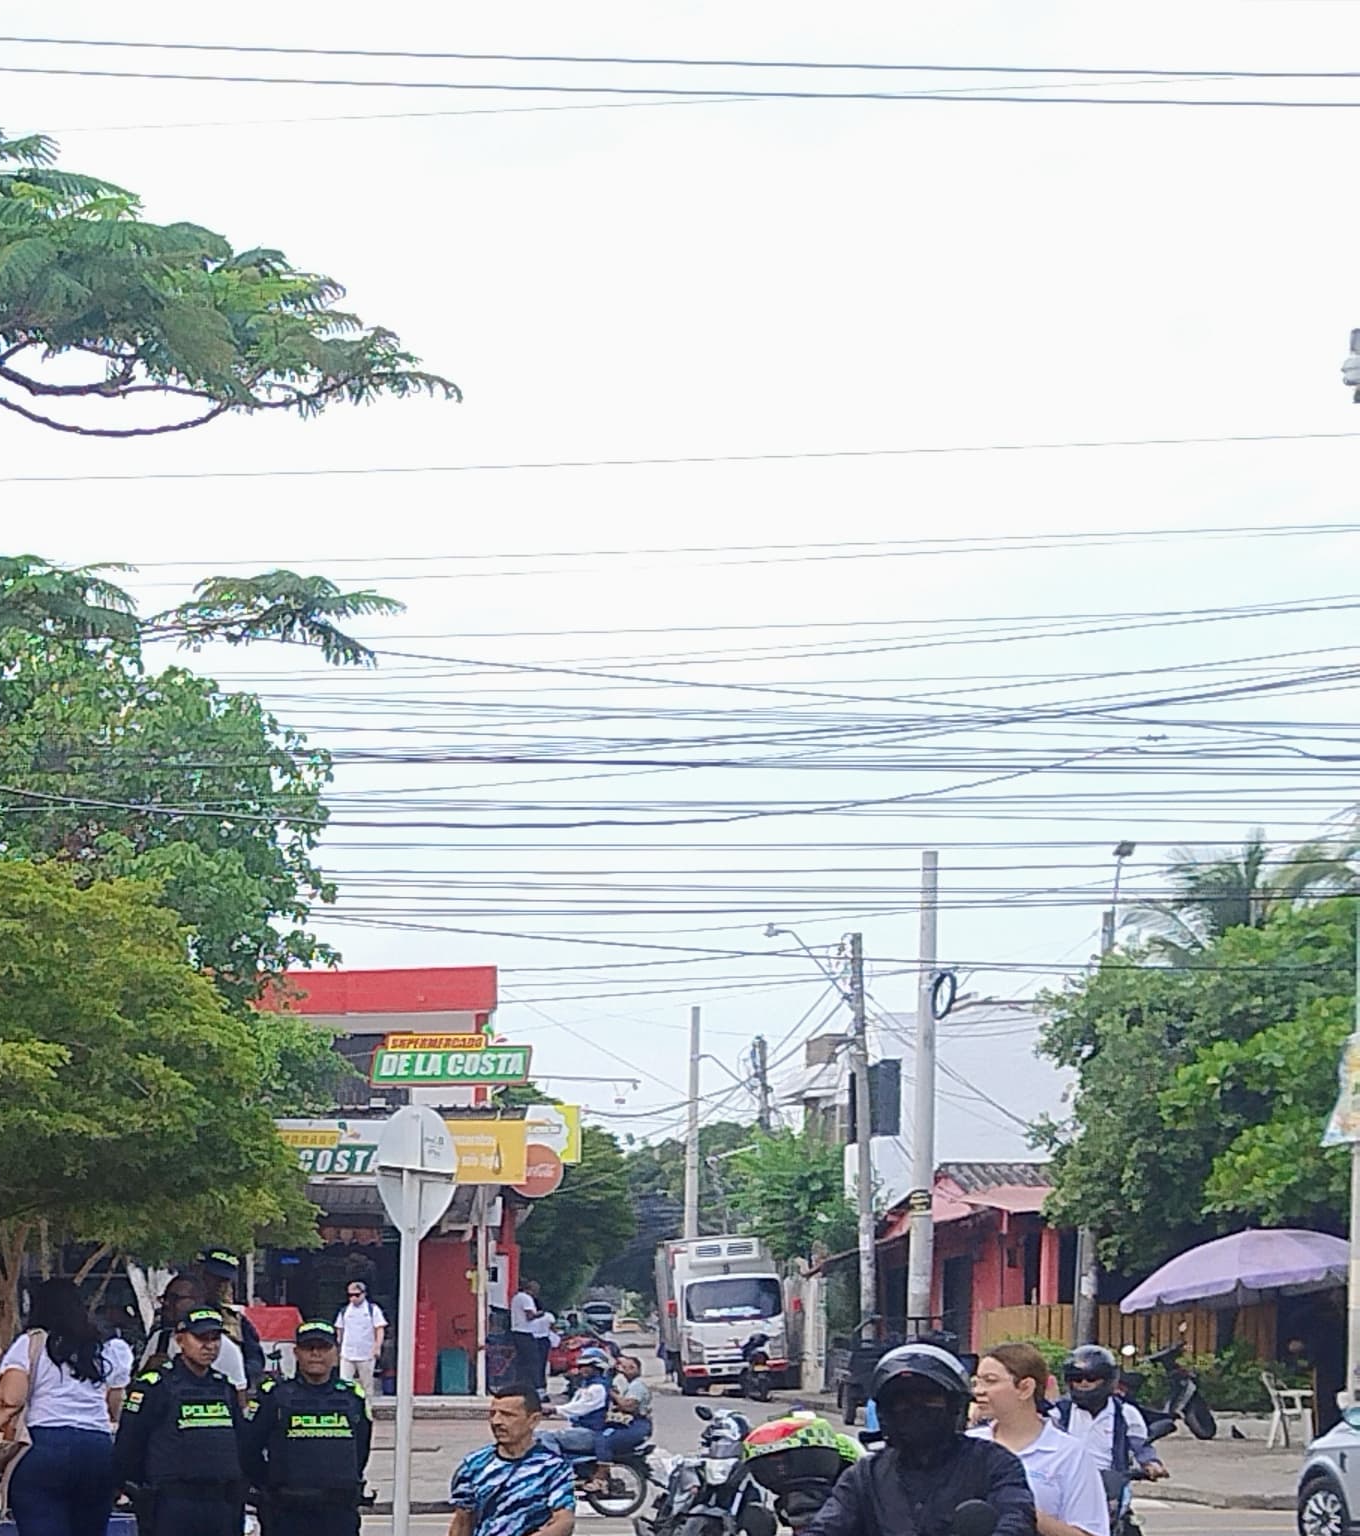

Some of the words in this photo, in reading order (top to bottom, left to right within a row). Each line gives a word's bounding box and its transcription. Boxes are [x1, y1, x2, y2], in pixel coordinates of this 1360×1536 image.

[380, 1054, 410, 1077] DE
[413, 1054, 442, 1077] LA
[447, 1052, 524, 1076] COSTA
